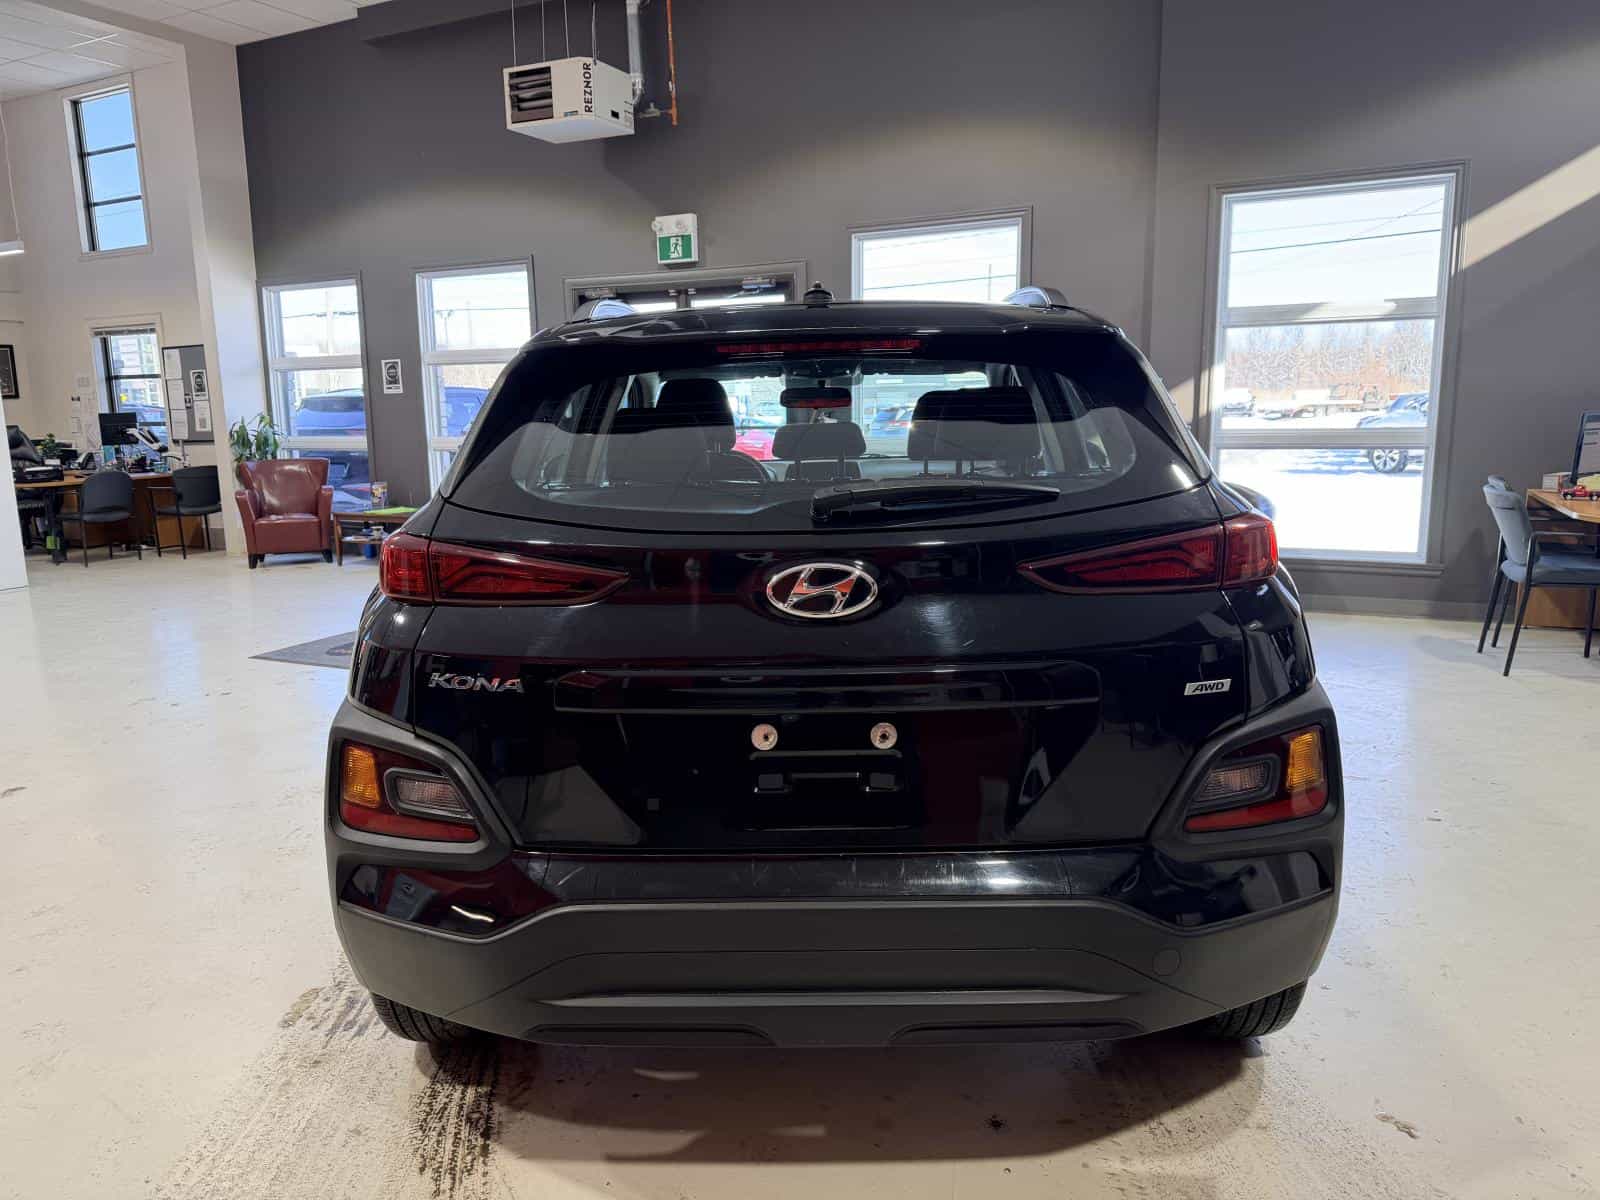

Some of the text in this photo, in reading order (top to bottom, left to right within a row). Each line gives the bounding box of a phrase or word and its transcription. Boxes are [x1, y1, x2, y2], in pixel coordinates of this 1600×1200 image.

[582, 62, 593, 113] REZNOR
[428, 672, 524, 693] KONA
[1191, 681, 1226, 694] AWD
